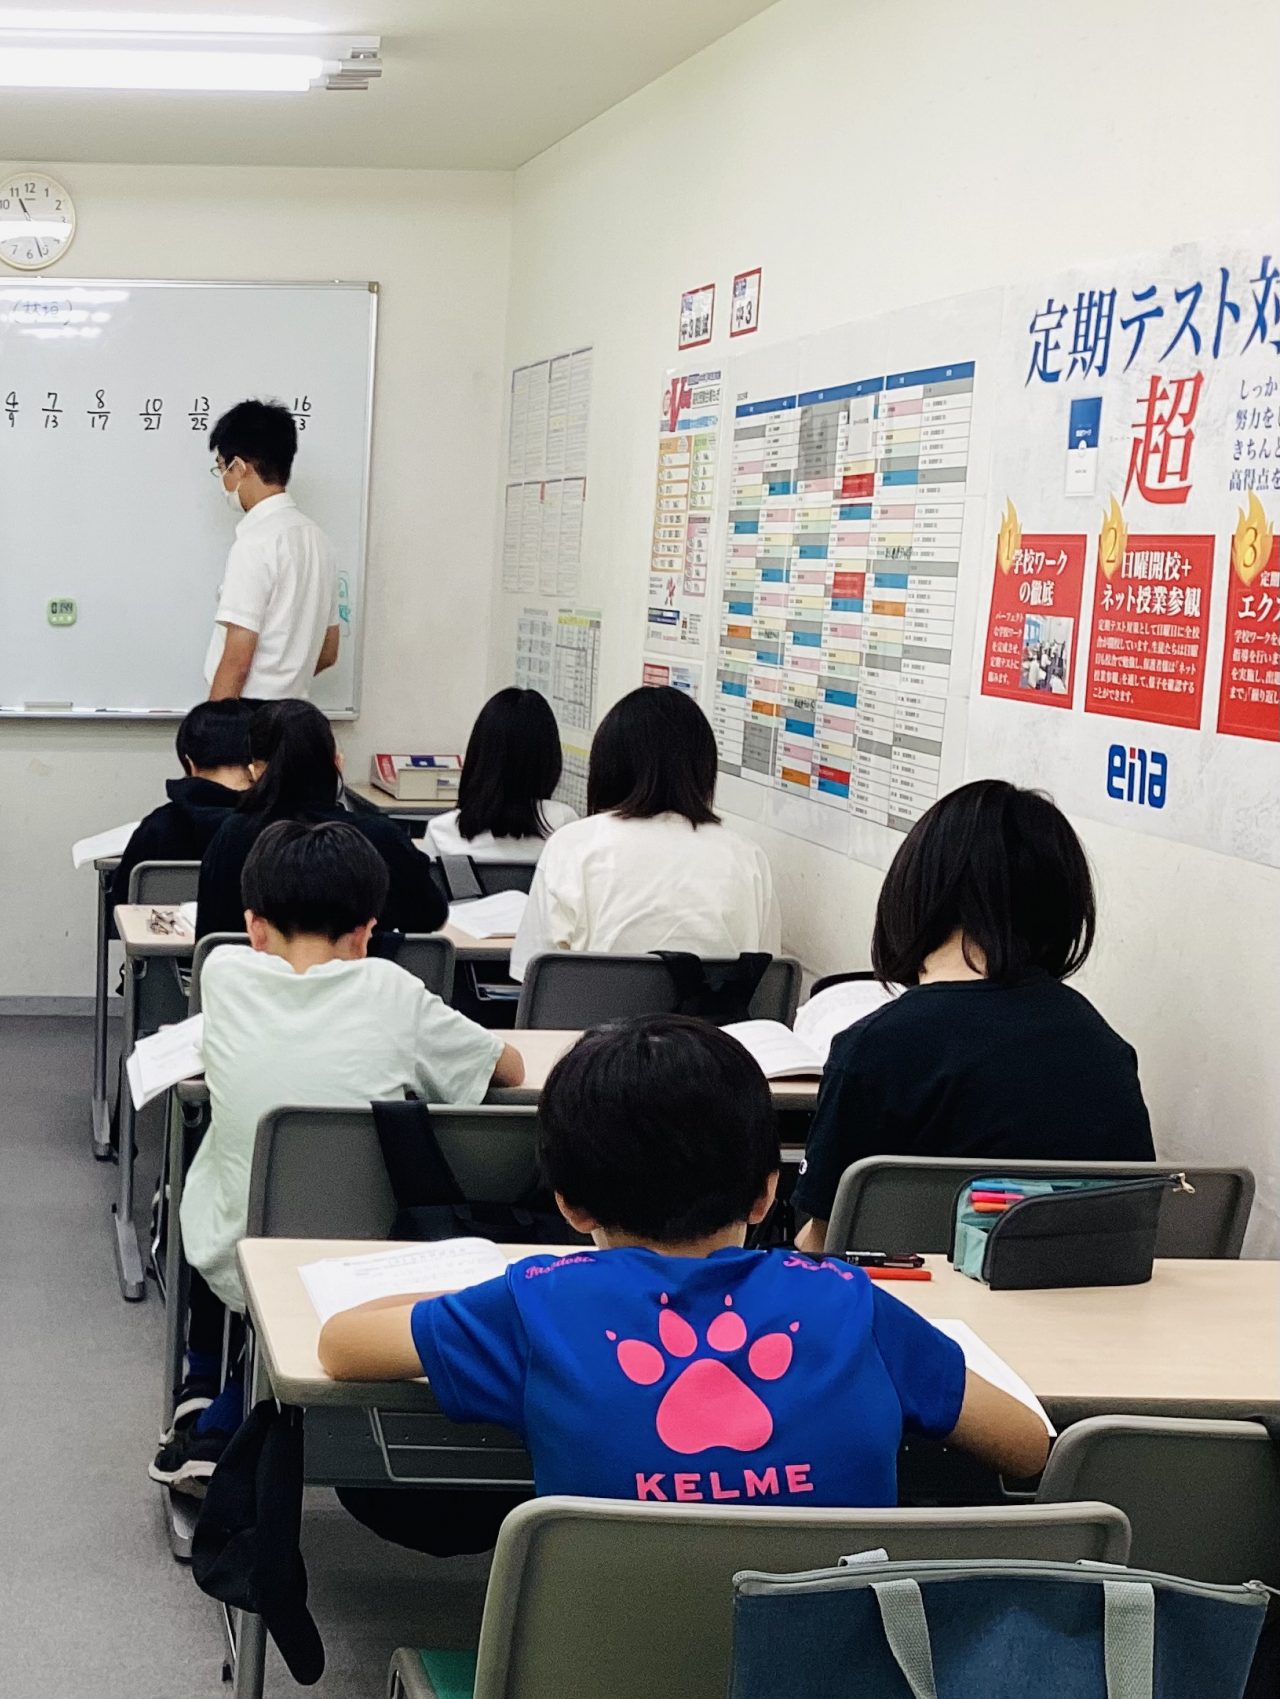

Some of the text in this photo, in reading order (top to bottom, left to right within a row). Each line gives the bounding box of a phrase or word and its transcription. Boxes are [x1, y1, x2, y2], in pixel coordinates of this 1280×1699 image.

[10, 187, 20, 197] 11
[24, 182, 36, 194] 12
[44, 187, 49, 198] 1
[0, 199, 10, 210] 10
[55, 199, 62, 211] 2
[10, 244, 18, 255] 7
[26, 249, 34, 260] 6
[1240, 375, 1278, 400] しっか
[5, 391, 18, 406] 4
[47, 392, 59, 408] 7
[95, 389, 105, 408] 8
[144, 398, 163, 412] 10
[193, 397, 210, 412] 13
[293, 395, 312, 412] 16
[8, 413, 16, 428] 9
[44, 415, 59, 430] 13
[91, 415, 109, 431] 17
[143, 416, 162, 431] 21
[191, 417, 209, 431] 25
[1122, 370, 1205, 507] 超
[1105, 527, 1118, 564] 2
[1242, 526, 1258, 568] 3
[1012, 548, 1068, 576] 学校ワーク
[1019, 579, 1056, 607] の徹底
[1100, 582, 1202, 618] ネット授業参観
[1106, 743, 1169, 810] ena
[635, 1463, 814, 1501] KELME
